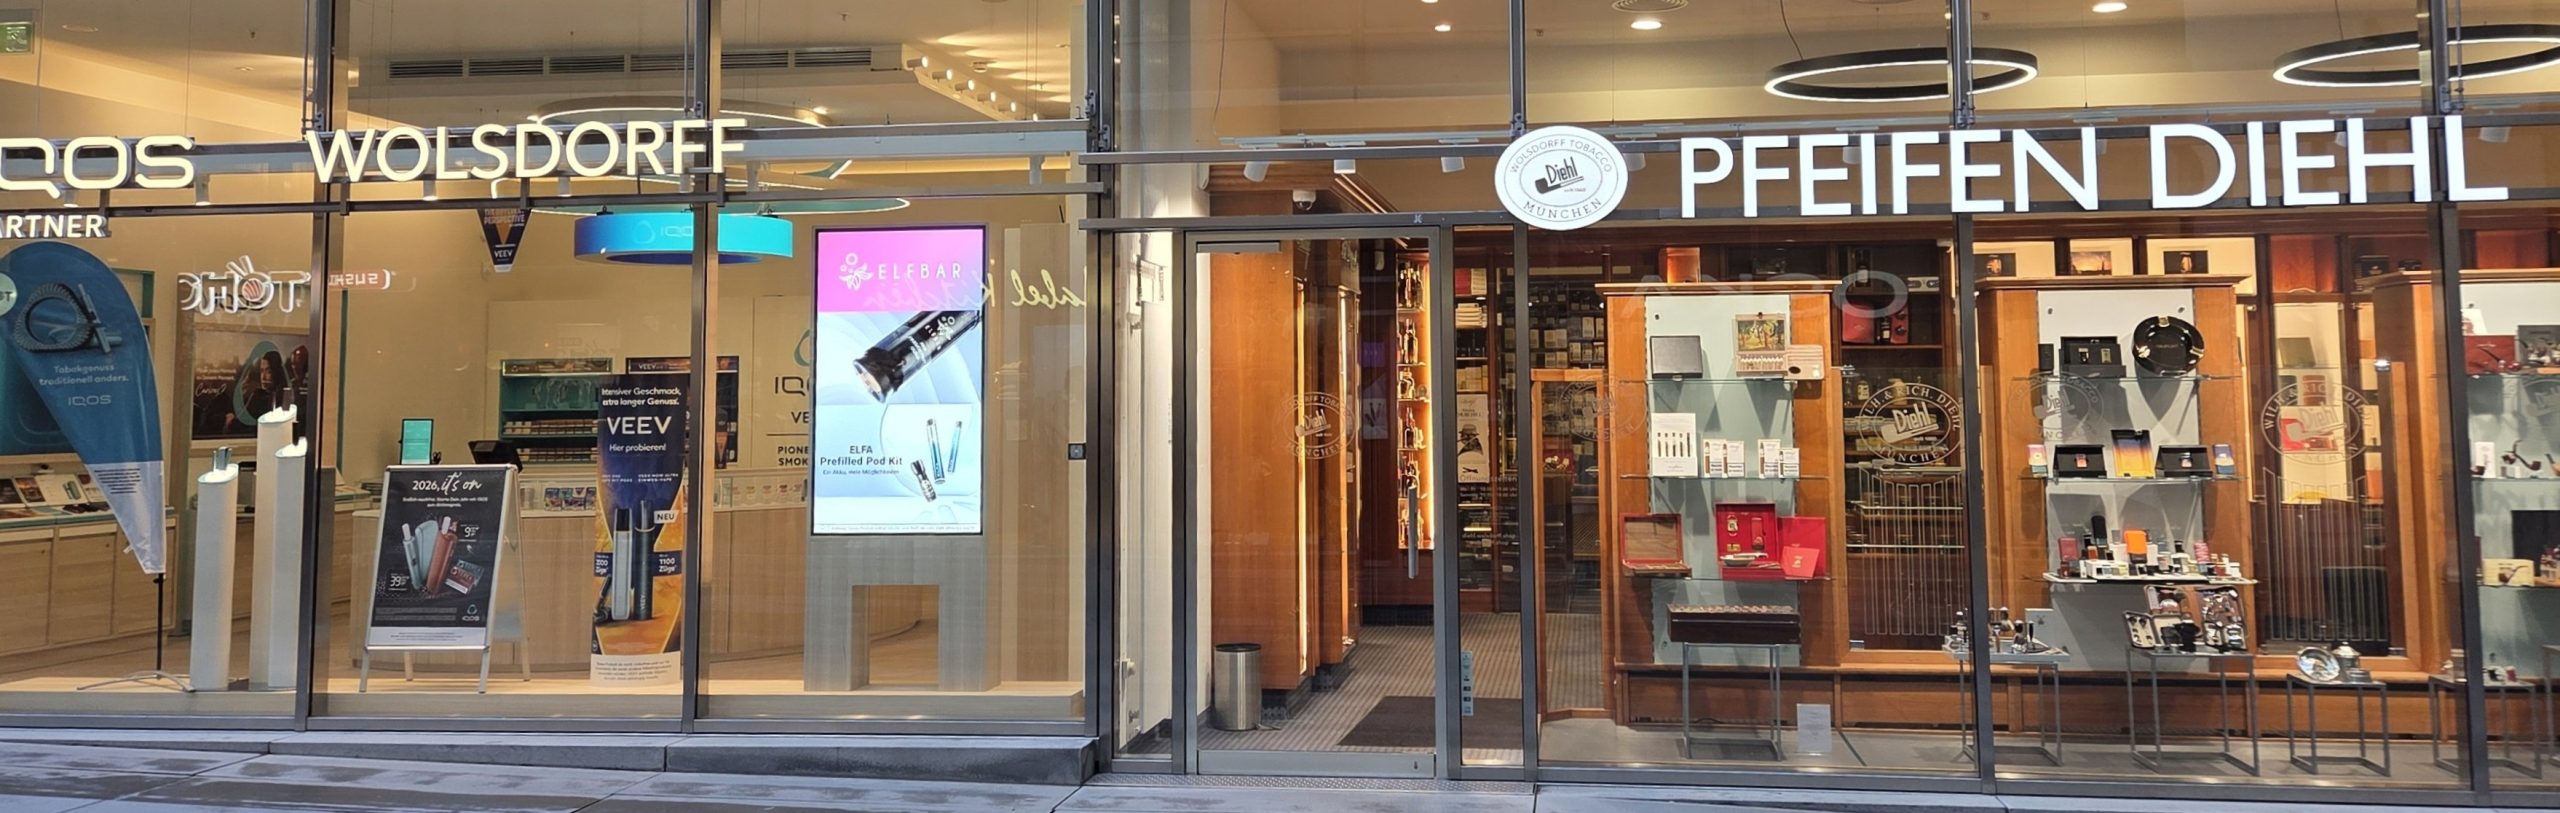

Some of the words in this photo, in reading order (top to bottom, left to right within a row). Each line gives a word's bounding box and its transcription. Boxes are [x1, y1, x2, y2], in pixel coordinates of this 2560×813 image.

[306, 117, 748, 184] WOLSDORFF
[1509, 138, 1567, 174] WOLSDORFF
[1569, 139, 1614, 174] TOBACCO
[0, 135, 195, 199] QOS
[1545, 156, 1579, 184] Diehl
[1681, 126, 2099, 219] PFEIFEN
[2149, 114, 2509, 209] DIEHL
[0, 214, 105, 238] RTNER
[877, 262, 962, 280] ELFBAR
[39, 374, 93, 386] traditionell
[94, 374, 130, 383] anders.
[53, 364, 115, 375] Tabakgenuss
[774, 376, 810, 397] IQ
[68, 394, 112, 407] IQOS
[1884, 390, 1893, 399] &
[1936, 393, 1961, 432] DIEHL
[606, 415, 673, 436] VEEV
[1892, 401, 1932, 433] Diehl
[609, 443, 626, 452] Hier
[625, 443, 667, 454] probieren!
[849, 445, 874, 455] ELFA
[820, 456, 863, 466] Prefilled
[866, 456, 886, 466] Pod
[888, 456, 903, 466] Kit
[412, 480, 440, 493] 2026,
[440, 471, 463, 496] it's
[462, 479, 482, 491] on
[656, 513, 676, 522] NEU
[658, 557, 676, 566] 1100
